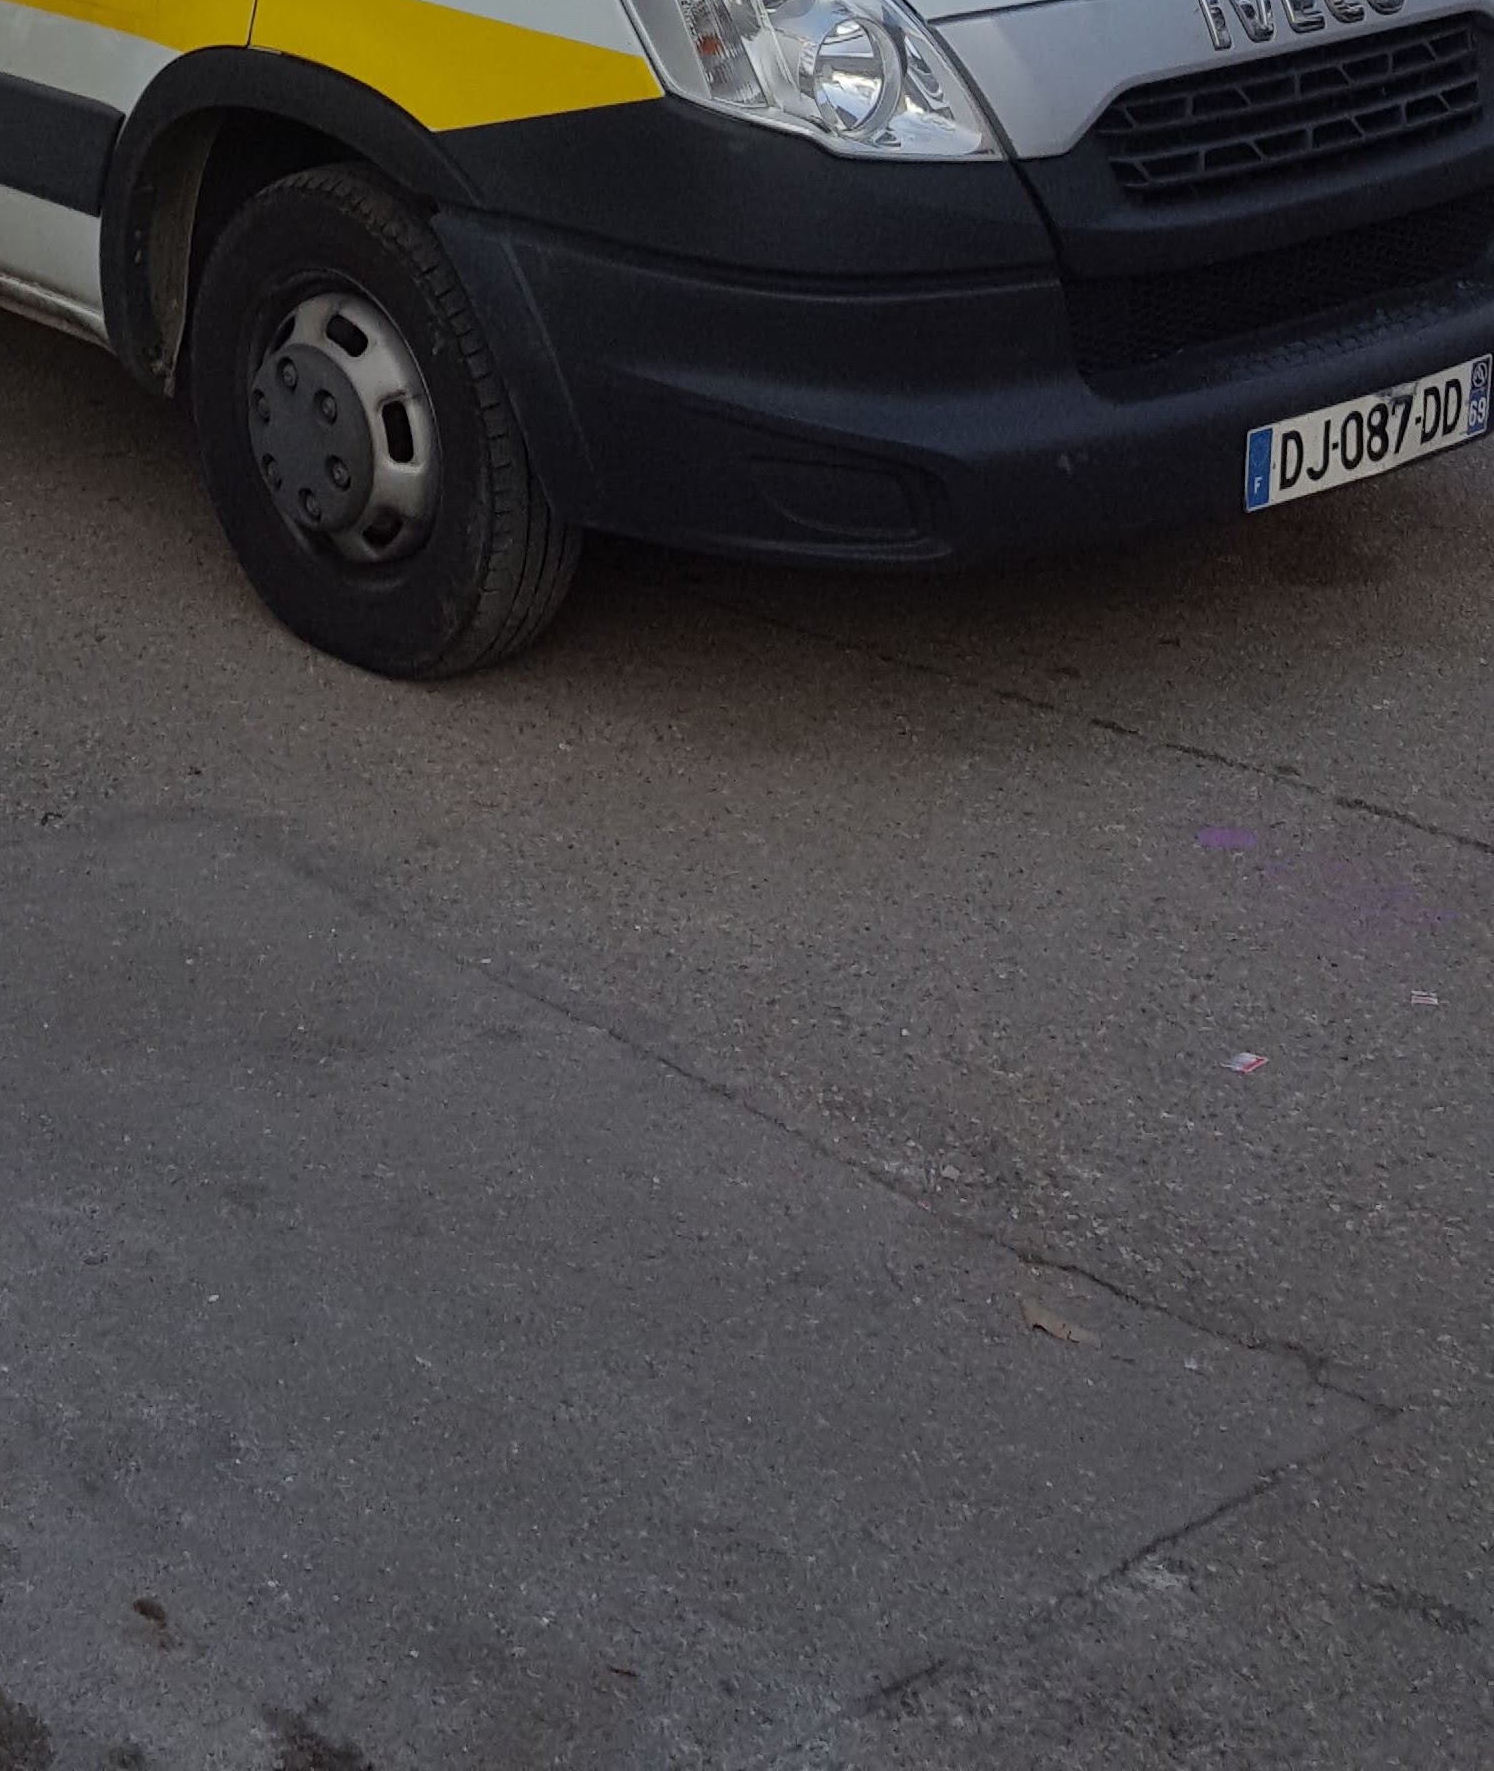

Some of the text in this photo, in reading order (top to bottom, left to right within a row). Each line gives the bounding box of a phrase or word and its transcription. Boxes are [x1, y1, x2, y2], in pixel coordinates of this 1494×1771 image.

[1254, 378, 1486, 495] F DJ-087-DD 69
